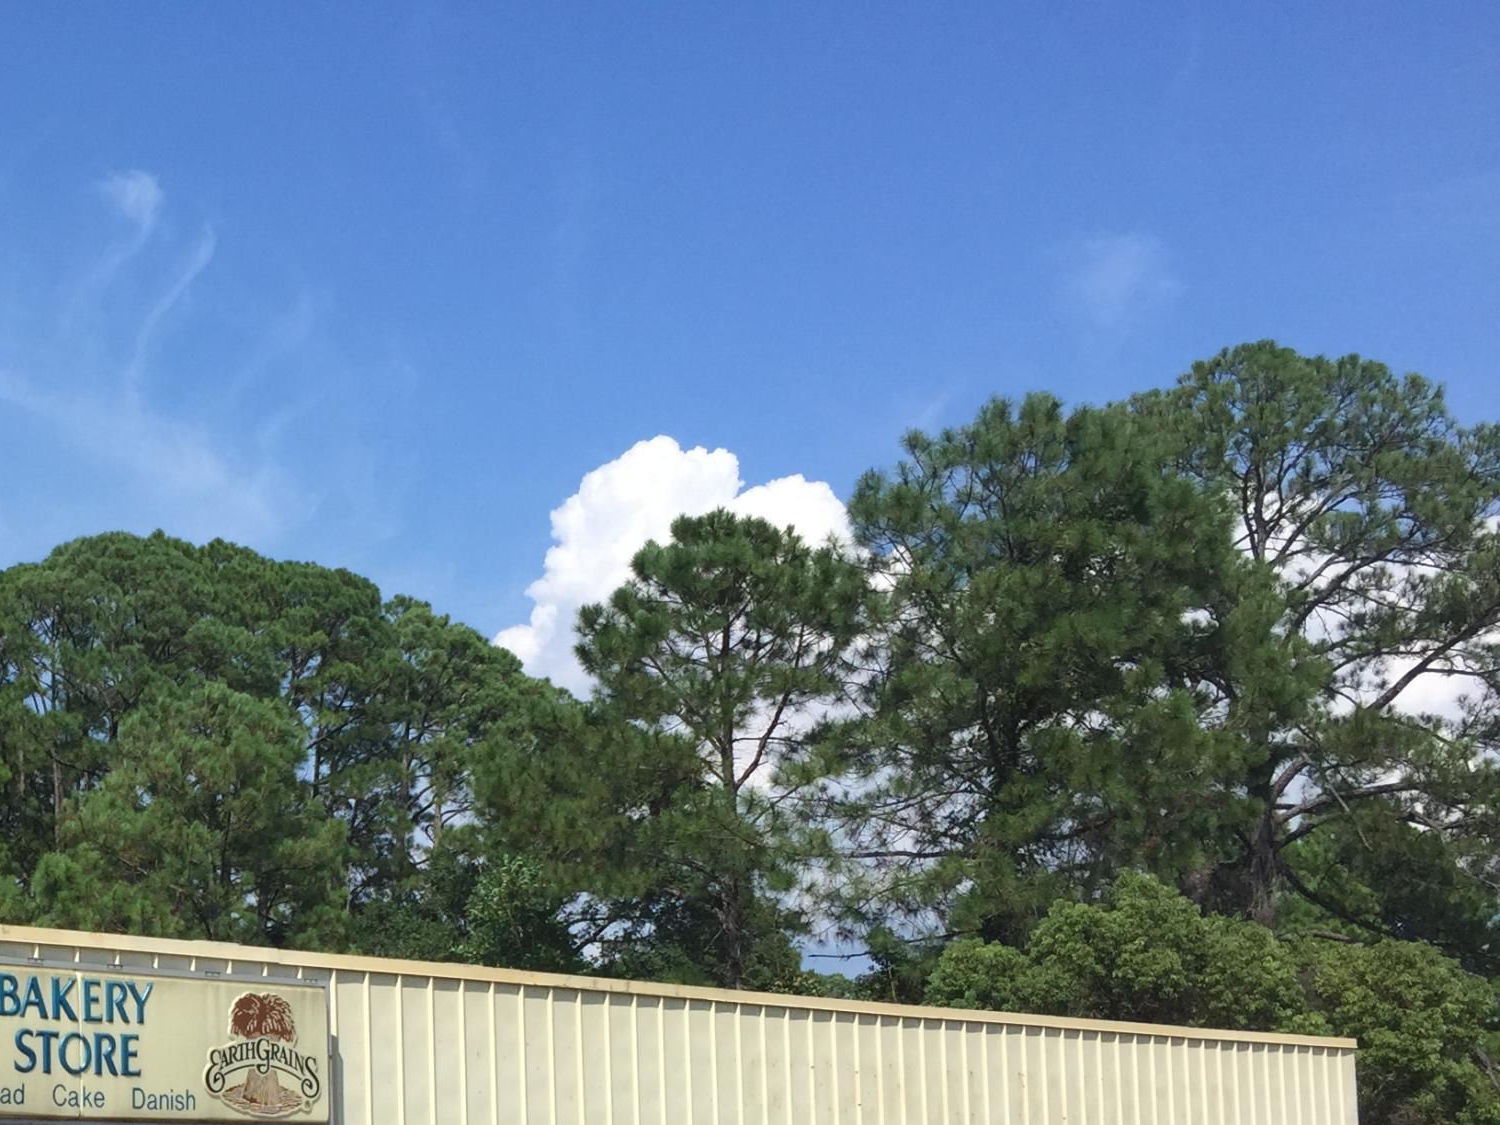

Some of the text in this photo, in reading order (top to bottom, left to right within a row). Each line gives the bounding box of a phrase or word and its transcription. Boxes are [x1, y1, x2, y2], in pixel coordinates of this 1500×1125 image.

[14, 1028, 142, 1077] STORE
[205, 1037, 320, 1099] EARTHGRAINS
[52, 1083, 105, 1108] Cake
[132, 1087, 196, 1111] Danish
